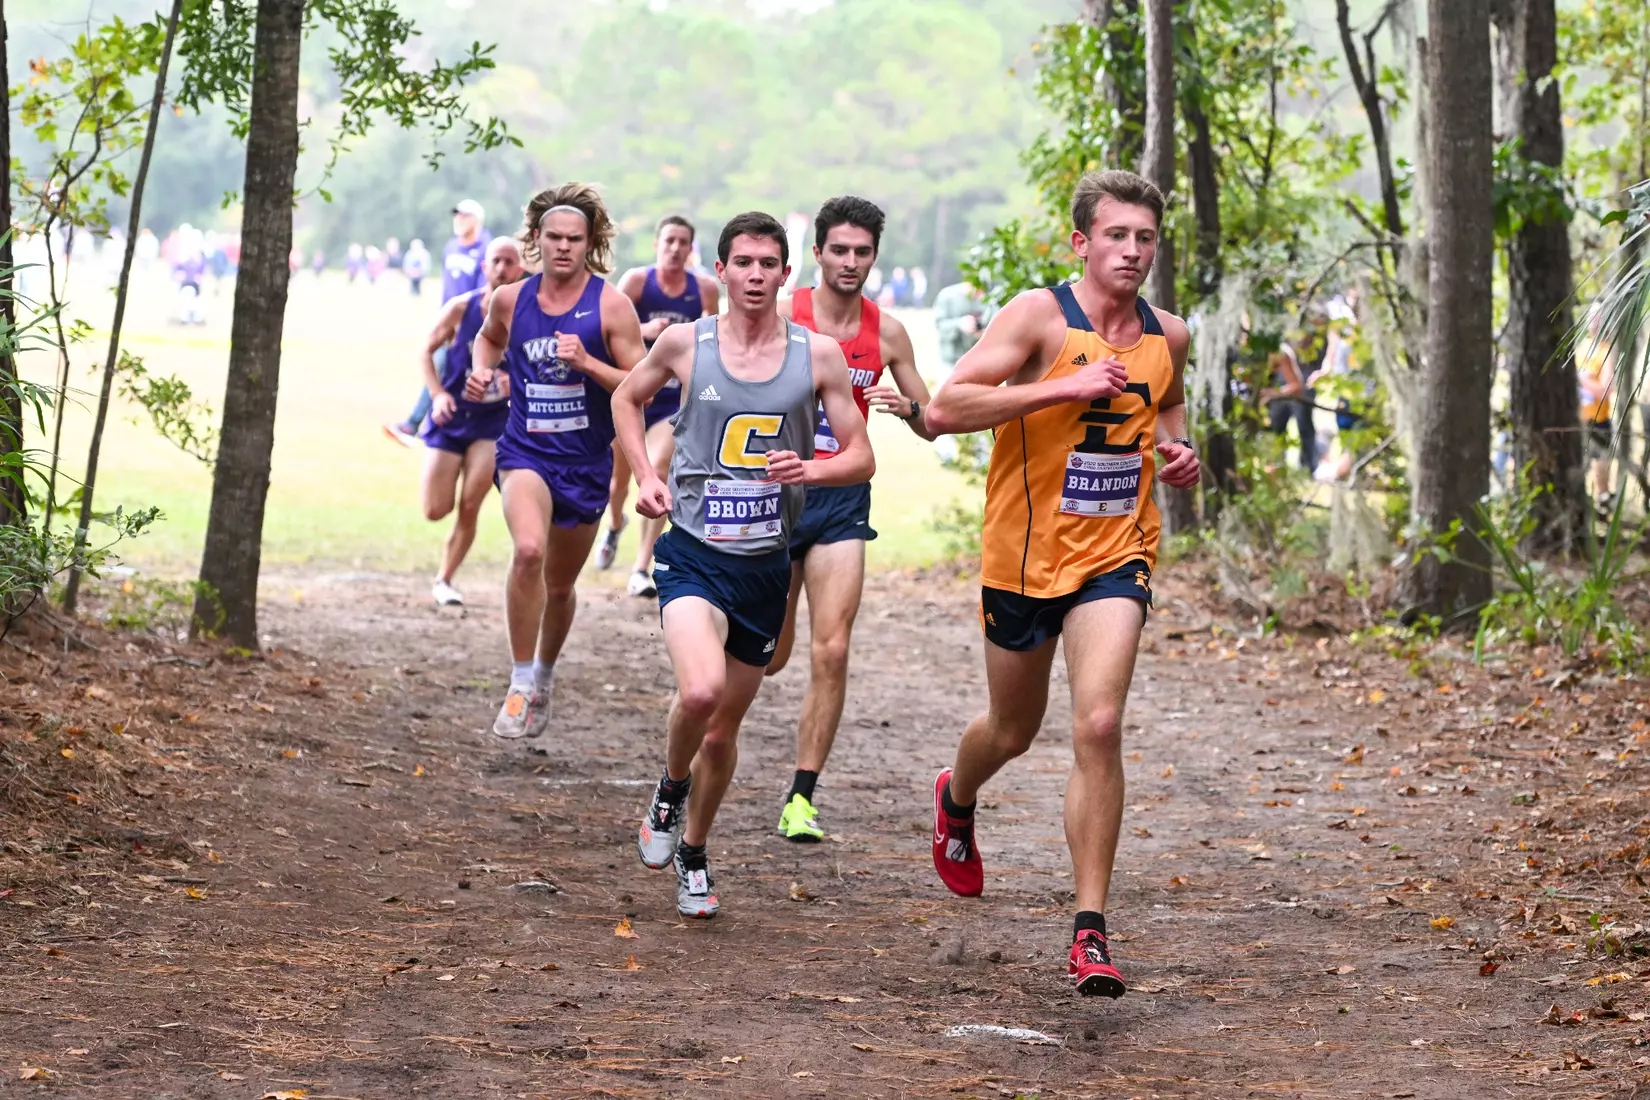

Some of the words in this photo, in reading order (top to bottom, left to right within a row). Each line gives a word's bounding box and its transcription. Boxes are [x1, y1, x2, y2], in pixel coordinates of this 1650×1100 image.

[528, 400, 585, 413] MITCHELL
[716, 411, 787, 471] C
[1067, 475, 1138, 491] BRANDON
[708, 497, 778, 518] BROWN
[1098, 502, 1107, 512] E
